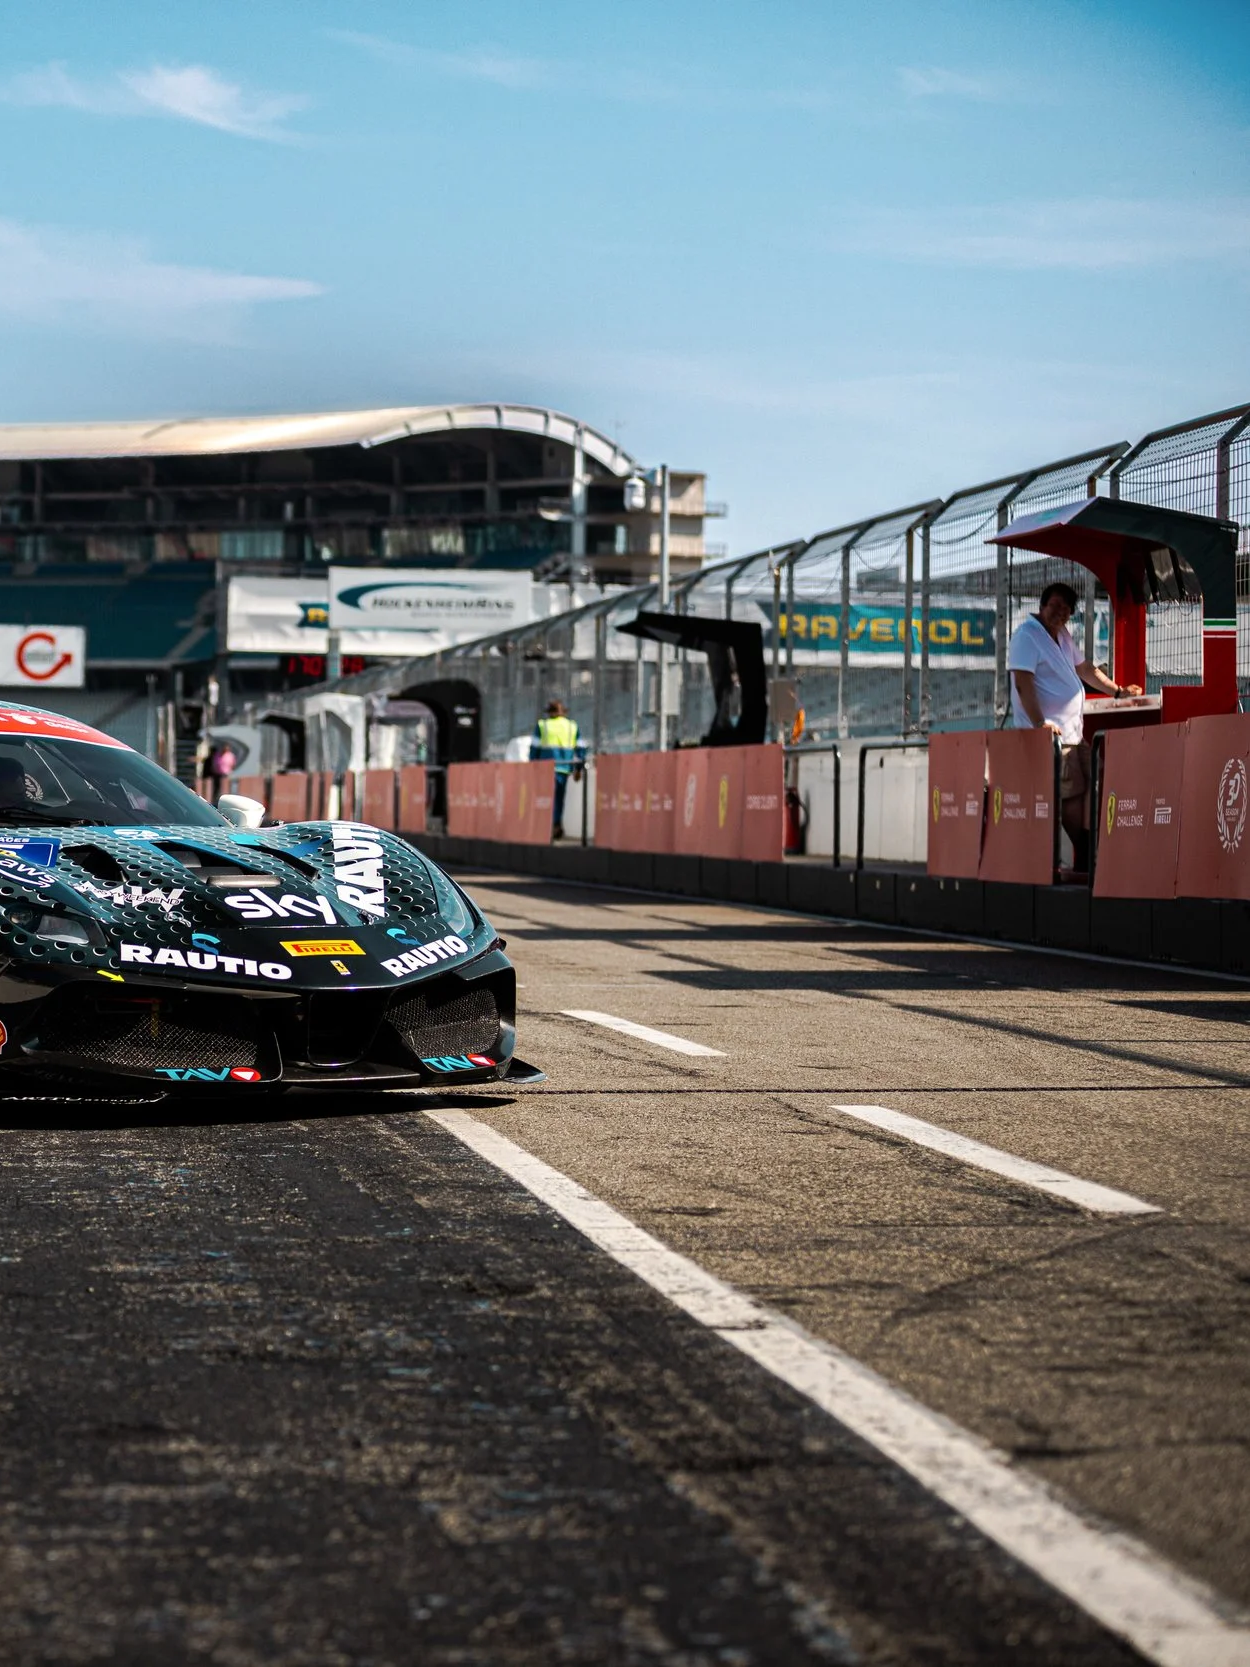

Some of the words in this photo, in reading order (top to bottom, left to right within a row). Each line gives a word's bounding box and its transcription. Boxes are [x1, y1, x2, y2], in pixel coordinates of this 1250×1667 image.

[778, 613, 984, 646] RAVENOL
[1118, 799, 1138, 812] FERRARI
[1154, 807, 1172, 825] PIRELLI
[1116, 814, 1144, 827] CHALLENGE
[224, 888, 337, 925] sky
[290, 943, 355, 953] PIRELLI
[380, 935, 469, 978] RAUTIO
[120, 942, 293, 980] RAUTIO
